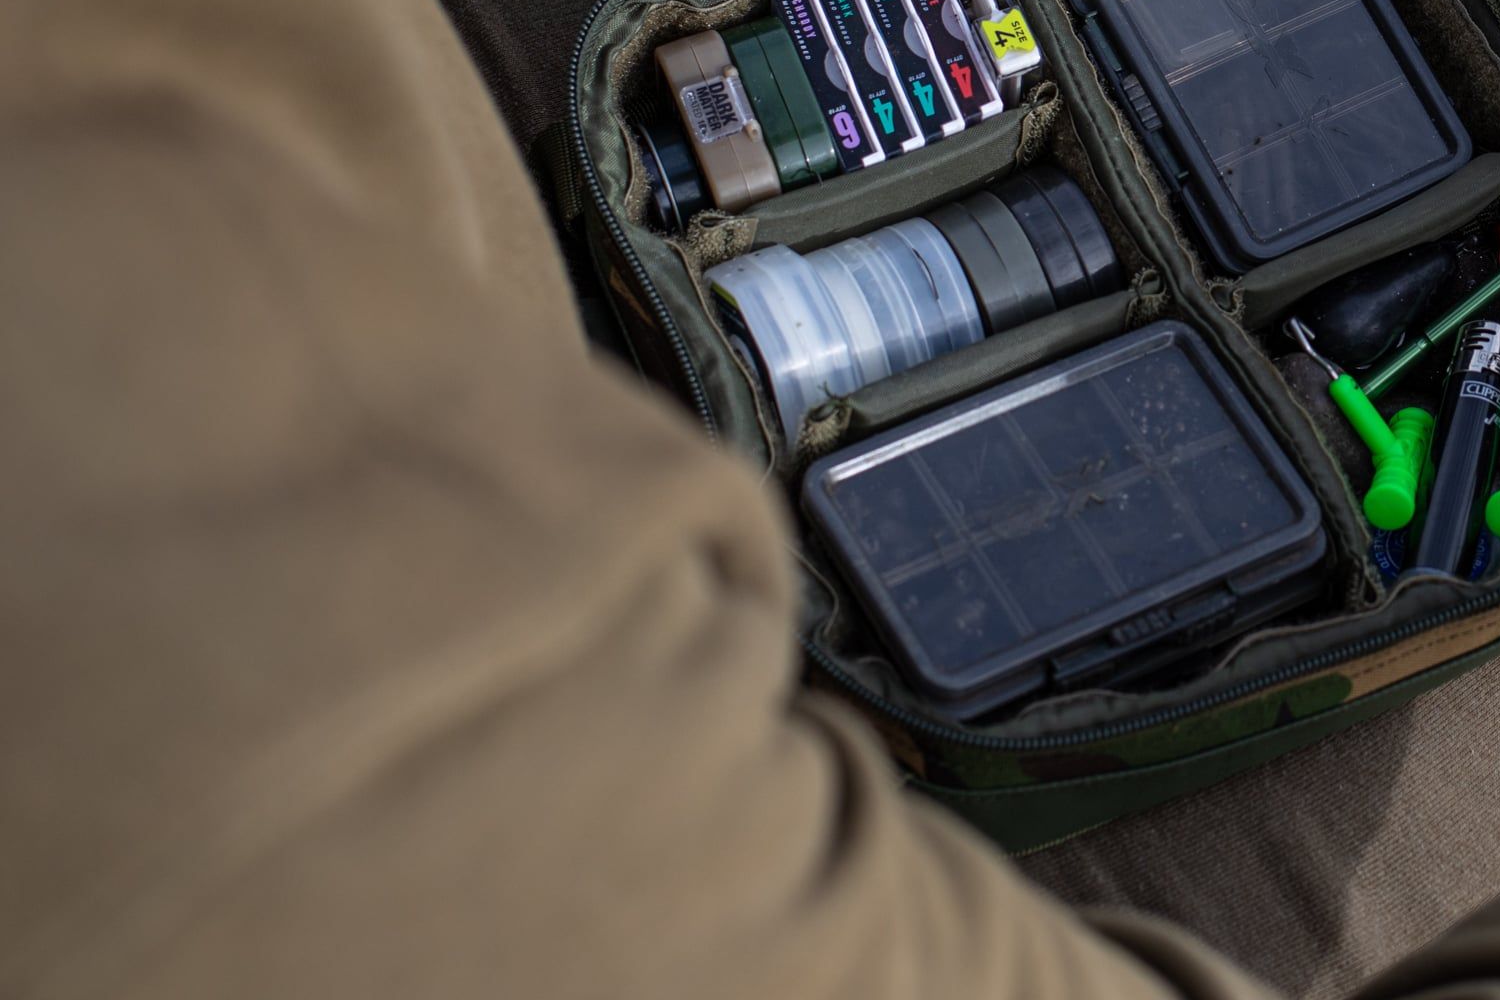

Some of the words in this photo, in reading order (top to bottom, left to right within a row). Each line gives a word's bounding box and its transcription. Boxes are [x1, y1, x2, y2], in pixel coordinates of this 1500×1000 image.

[994, 29, 1015, 48] 4
[1011, 20, 1028, 43] SIZE
[912, 80, 935, 117] 4
[950, 62, 973, 98] 4
[696, 86, 722, 132] MATTER
[708, 81, 739, 126] DARK
[873, 98, 895, 135] 4
[833, 111, 861, 149] 6
